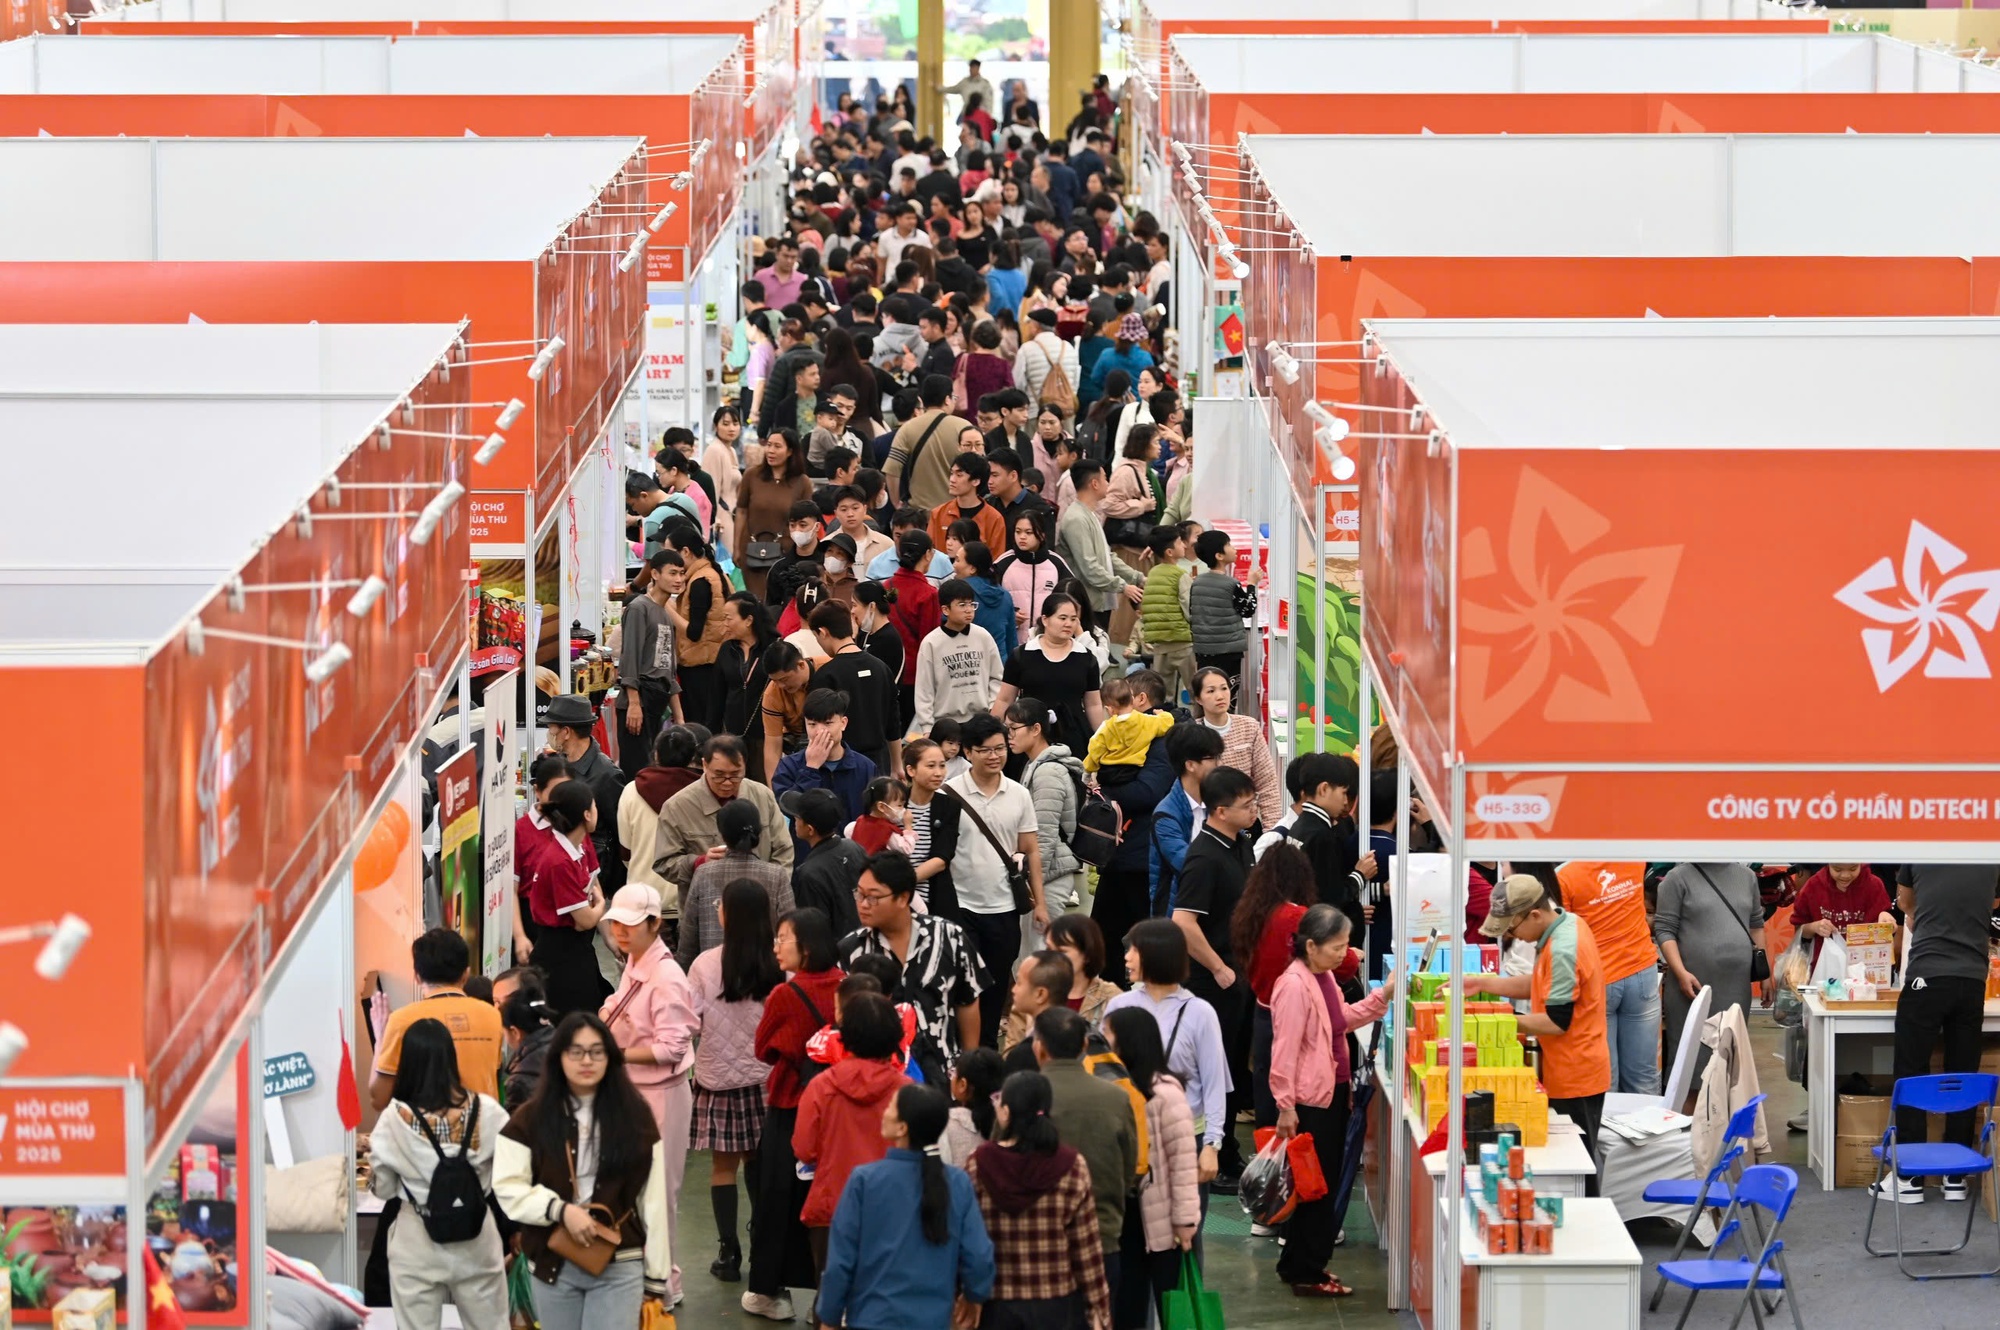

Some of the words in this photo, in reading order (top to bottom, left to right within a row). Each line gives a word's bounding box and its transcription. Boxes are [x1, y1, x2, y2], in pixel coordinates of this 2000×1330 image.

[470, 501, 481, 513] ỘI
[483, 502, 505, 513] CHỢ
[470, 513, 486, 524] ÙA
[487, 515, 508, 524] THU
[470, 527, 489, 536] 025
[490, 653, 504, 666] Gia
[1483, 802, 1542, 815] H5-33G
[1707, 793, 1770, 819] CÔNG
[1774, 798, 1803, 819] TY
[1806, 789, 1838, 819] CỔ
[1843, 792, 1903, 819] PHẦN
[1909, 798, 1988, 819] DETECH
[15, 1098, 47, 1120] HỘI
[50, 1098, 90, 1120] CHỢ
[15, 1121, 56, 1139] MÙA
[59, 1123, 96, 1141] THU
[17, 1145, 62, 1163] 2025
